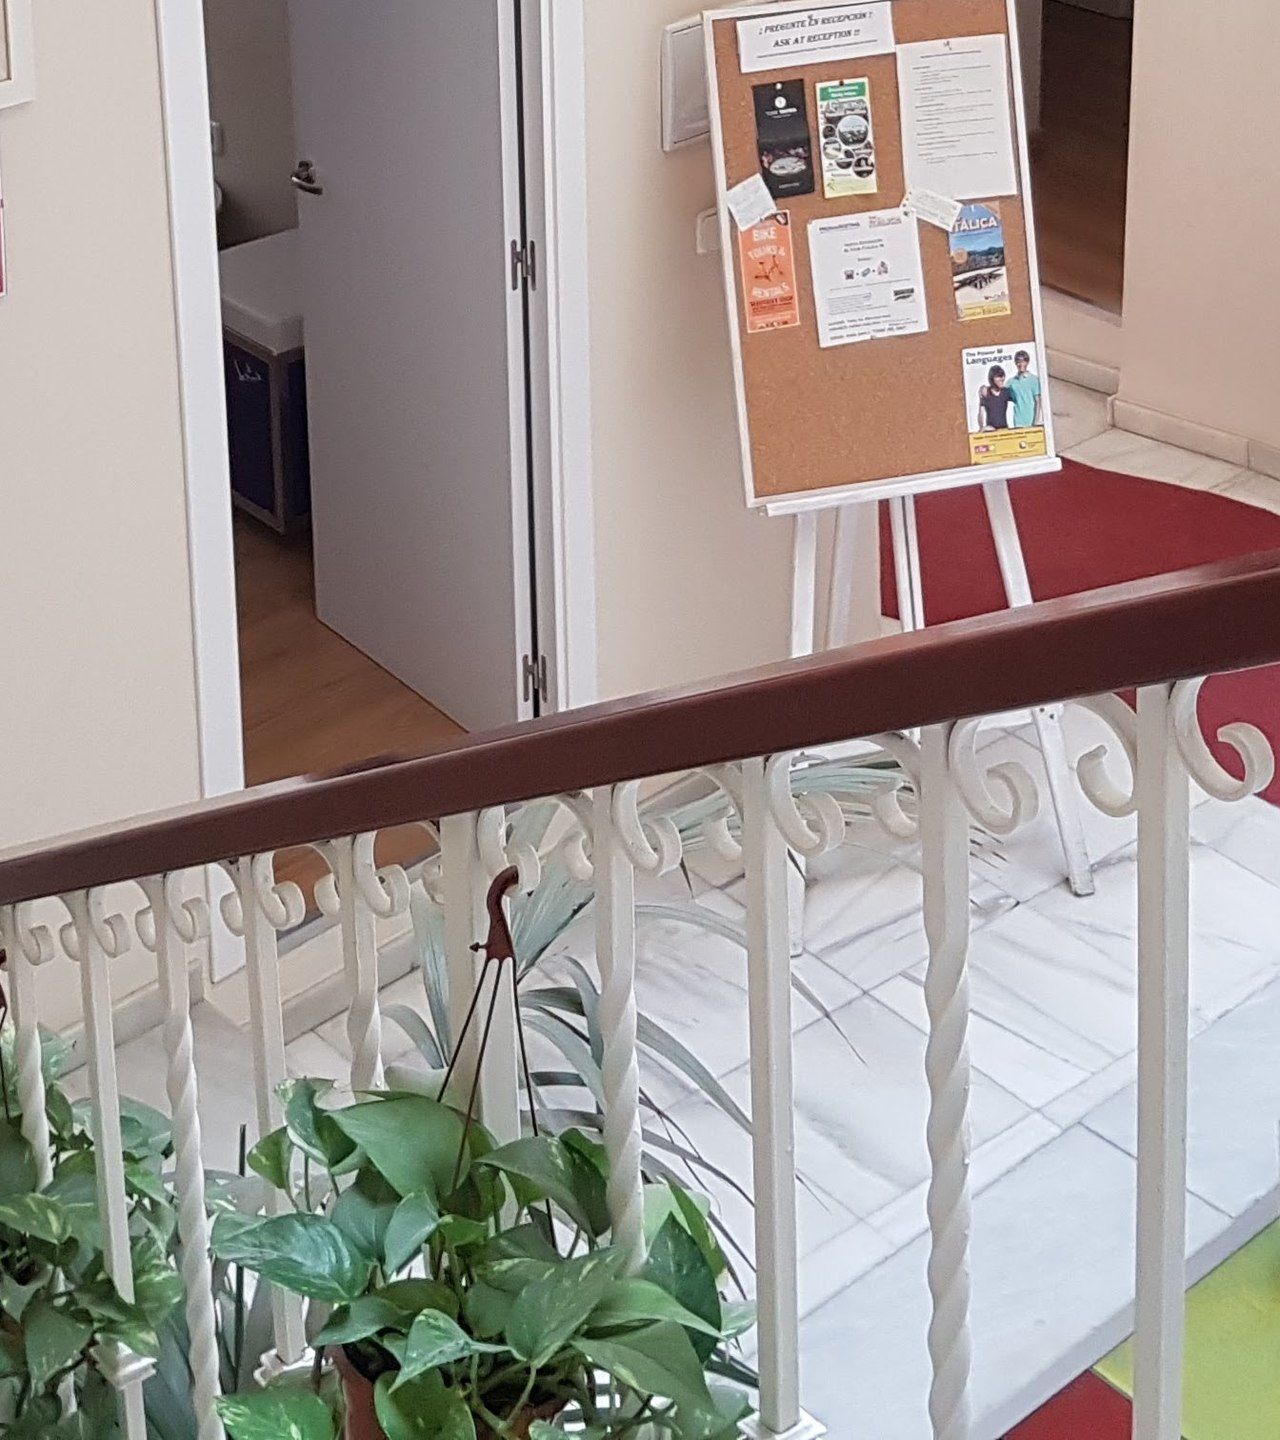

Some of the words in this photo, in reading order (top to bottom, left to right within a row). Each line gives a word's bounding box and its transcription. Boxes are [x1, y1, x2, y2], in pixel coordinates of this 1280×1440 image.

[773, 37, 791, 47] ASK
[793, 35, 806, 45] AT
[807, 30, 852, 43] RECEPTION
[952, 216, 998, 233] TALICA
[752, 227, 777, 242] BIKE
[965, 354, 1013, 366] Languages
[966, 350, 976, 358] The
[977, 349, 996, 357] Power
